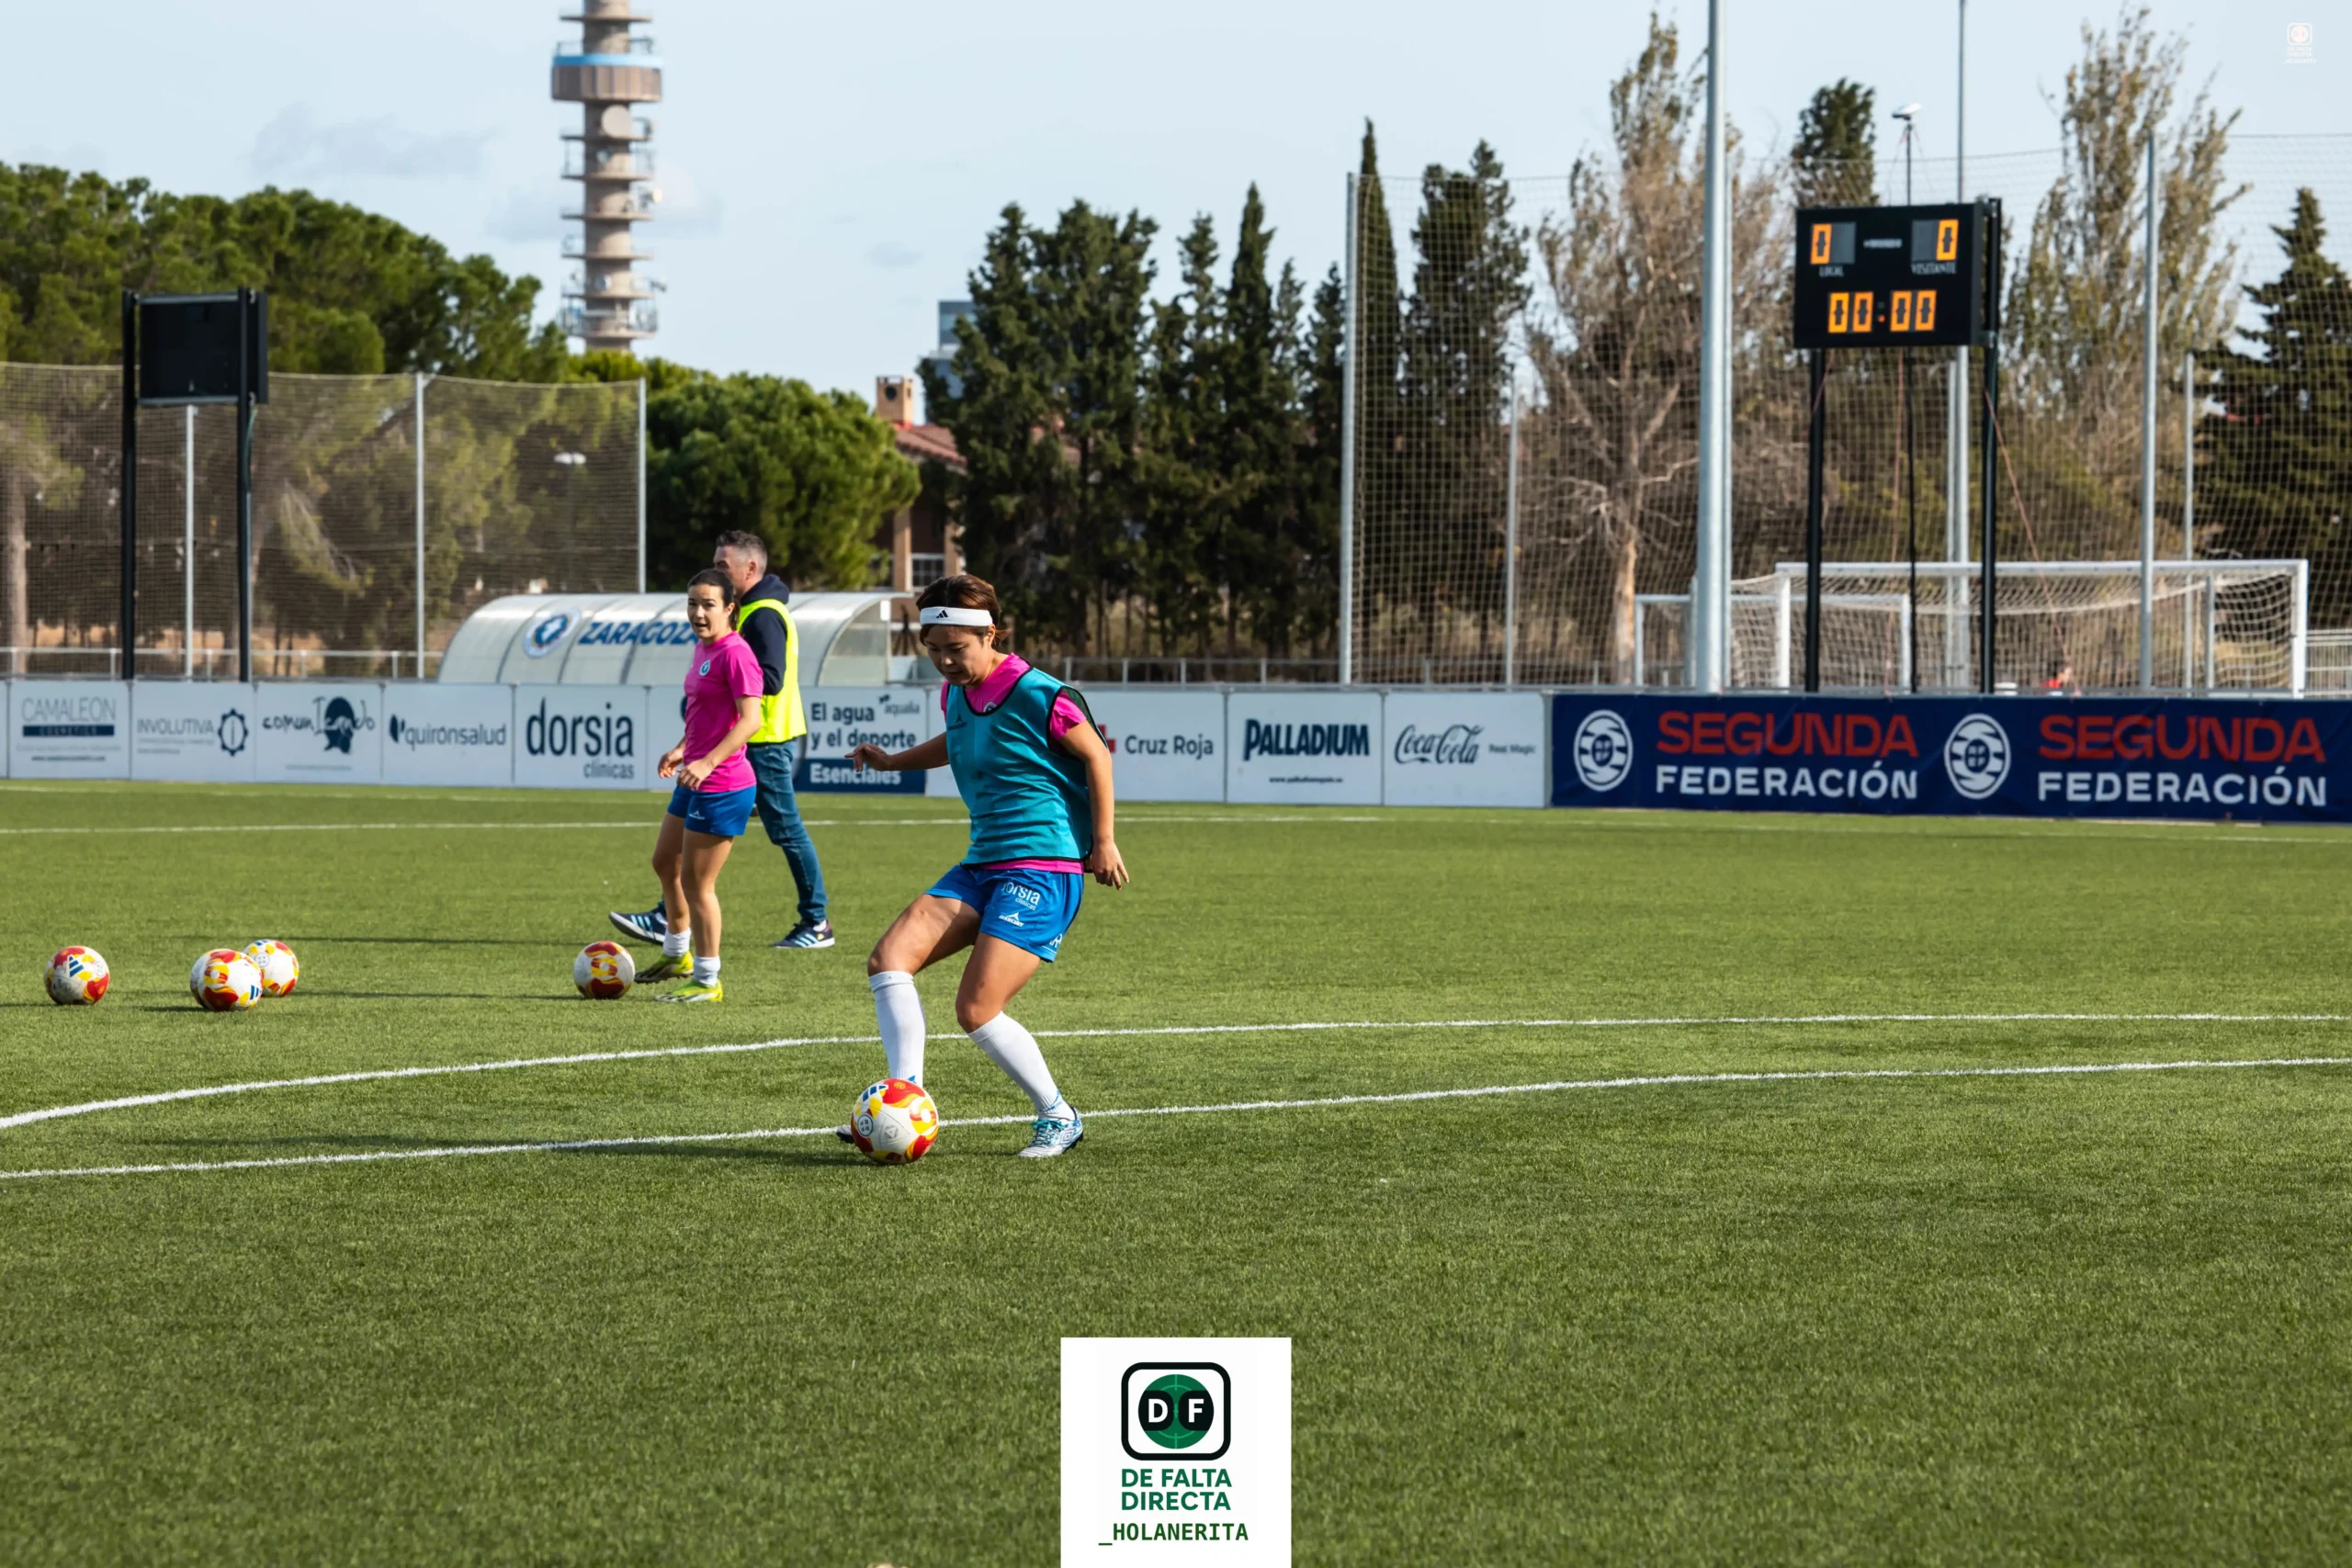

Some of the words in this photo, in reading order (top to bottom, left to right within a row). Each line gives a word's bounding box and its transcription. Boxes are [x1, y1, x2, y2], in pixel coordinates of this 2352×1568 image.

[1810, 223, 1832, 265] 0
[1936, 219, 1959, 261] 0
[1828, 290, 1937, 333] 00:00
[137, 717, 215, 735] INVOLUTIVA
[526, 695, 634, 757] dorsia
[810, 702, 826, 721] El
[832, 705, 875, 725] agua
[1657, 710, 1918, 757] SEGUNDA
[811, 732, 820, 751] y
[827, 728, 842, 747] el
[1125, 734, 1168, 755] Cruz
[1173, 733, 1214, 761] Roja
[1243, 718, 1370, 761] PALLADIUM
[2039, 715, 2326, 762] SEGUNDA
[1657, 761, 1918, 799] FEDERACIÓN
[2038, 766, 2326, 807] FEDERACIÓN
